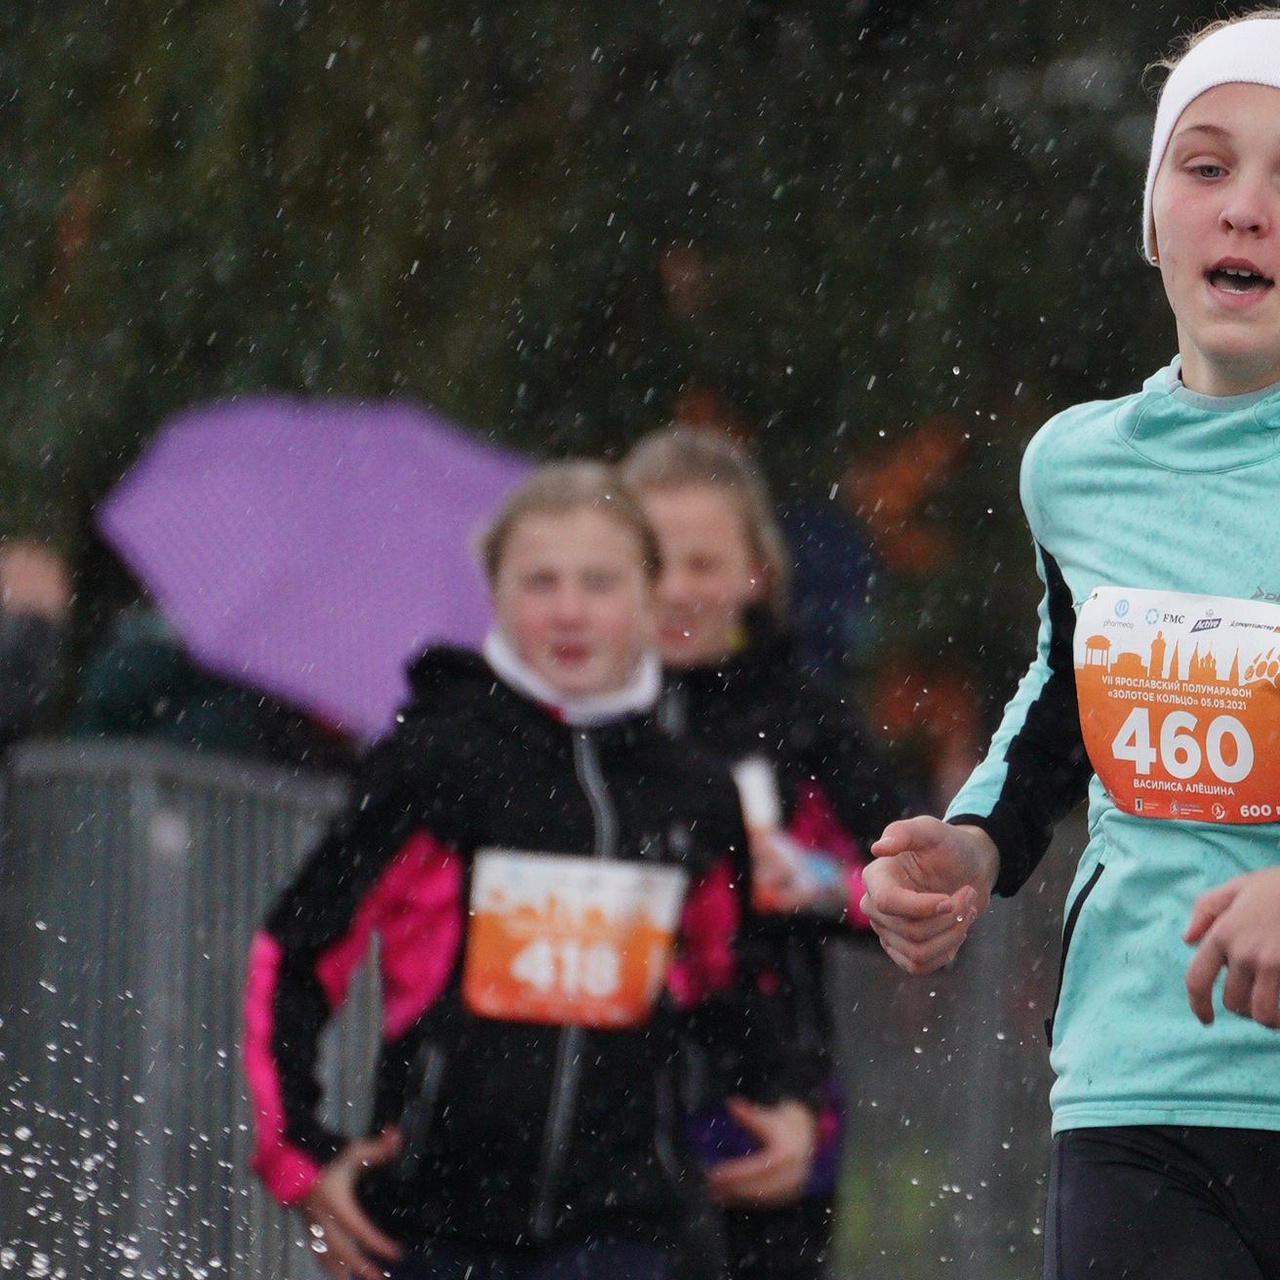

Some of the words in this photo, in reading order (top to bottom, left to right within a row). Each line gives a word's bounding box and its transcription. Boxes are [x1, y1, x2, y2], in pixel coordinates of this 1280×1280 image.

[1163, 613, 1185, 625] FMC
[1101, 675, 1113, 685] VII
[1115, 677, 1180, 691] ЯРОСЛАВСКИЙ
[1182, 680, 1252, 698] ПОЛУМАРАФОН
[1201, 697, 1247, 711] 05.09.2021
[1111, 706, 1255, 784] 460
[1133, 778, 1184, 792] ВАСИЛИСА
[1185, 781, 1235, 796] АЛЁШИНА
[1240, 804, 1272, 818] 600
